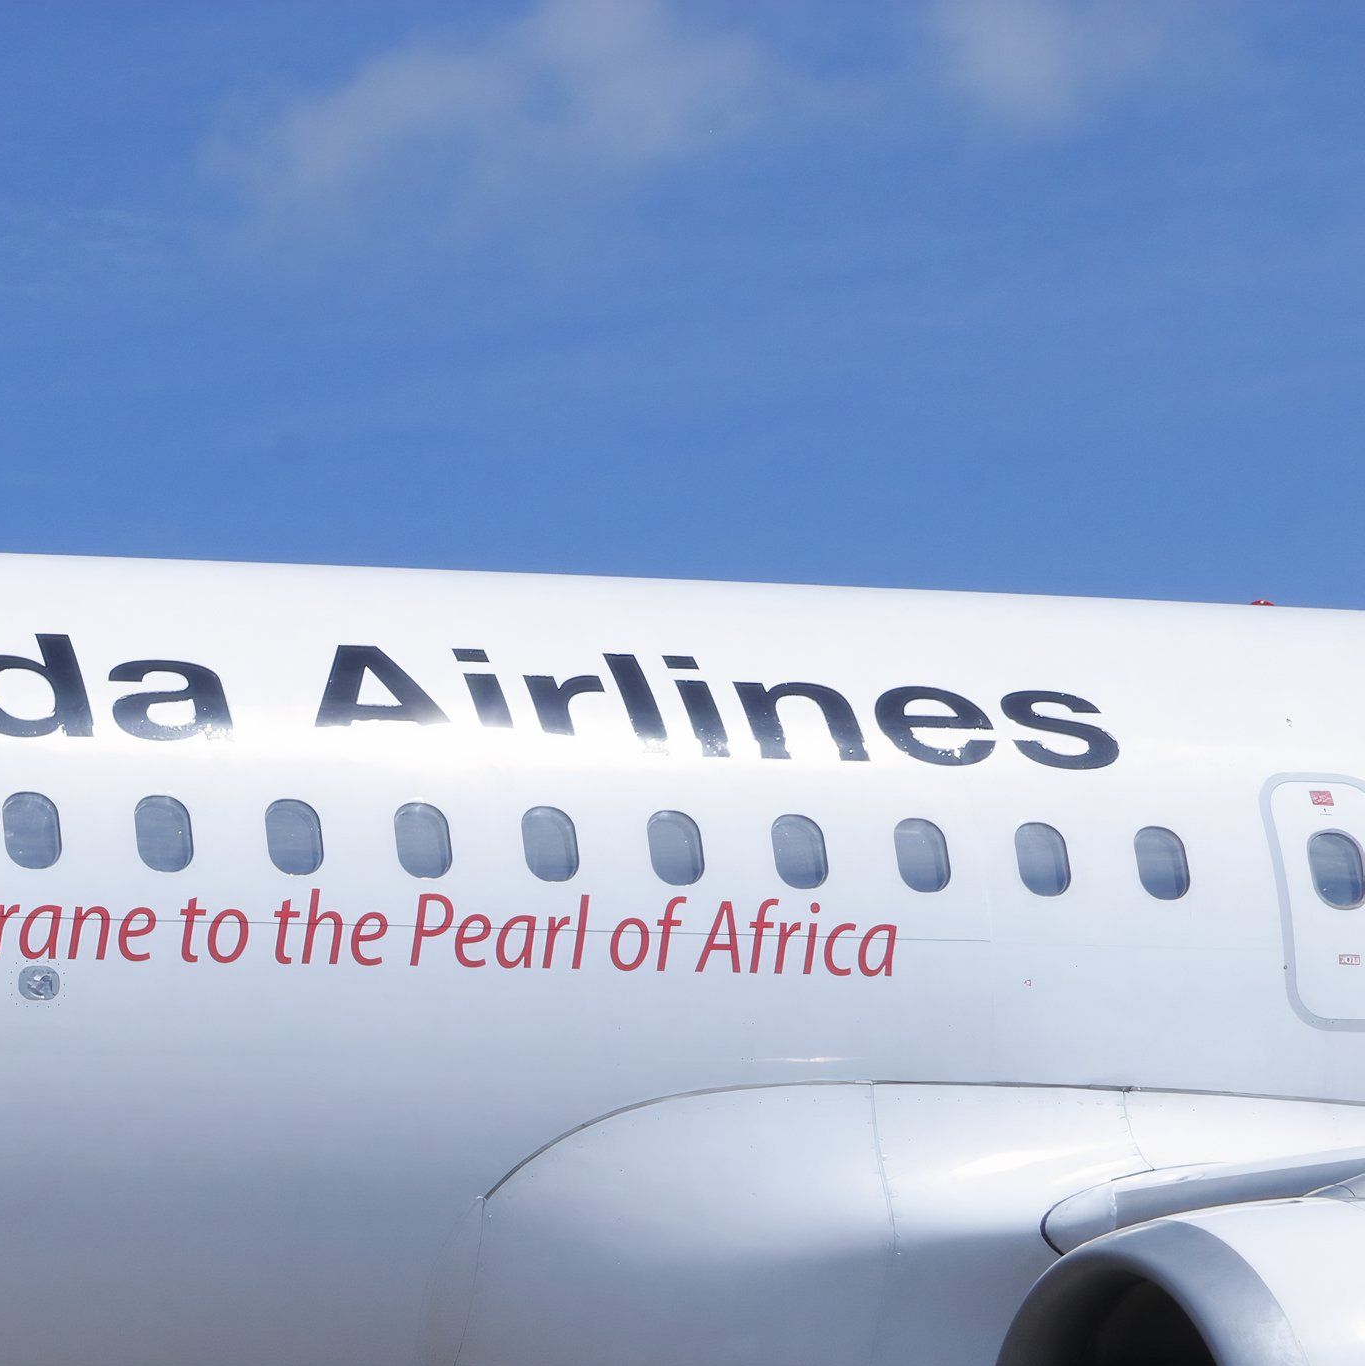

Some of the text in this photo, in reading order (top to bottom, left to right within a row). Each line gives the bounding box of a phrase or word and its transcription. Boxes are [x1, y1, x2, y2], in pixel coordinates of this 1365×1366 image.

[315, 645, 1120, 770] Airlines
[180, 898, 249, 964] to
[275, 889, 389, 967] the
[411, 894, 590, 970] Pearl
[610, 896, 687, 973] of
[697, 900, 897, 977] Africa
